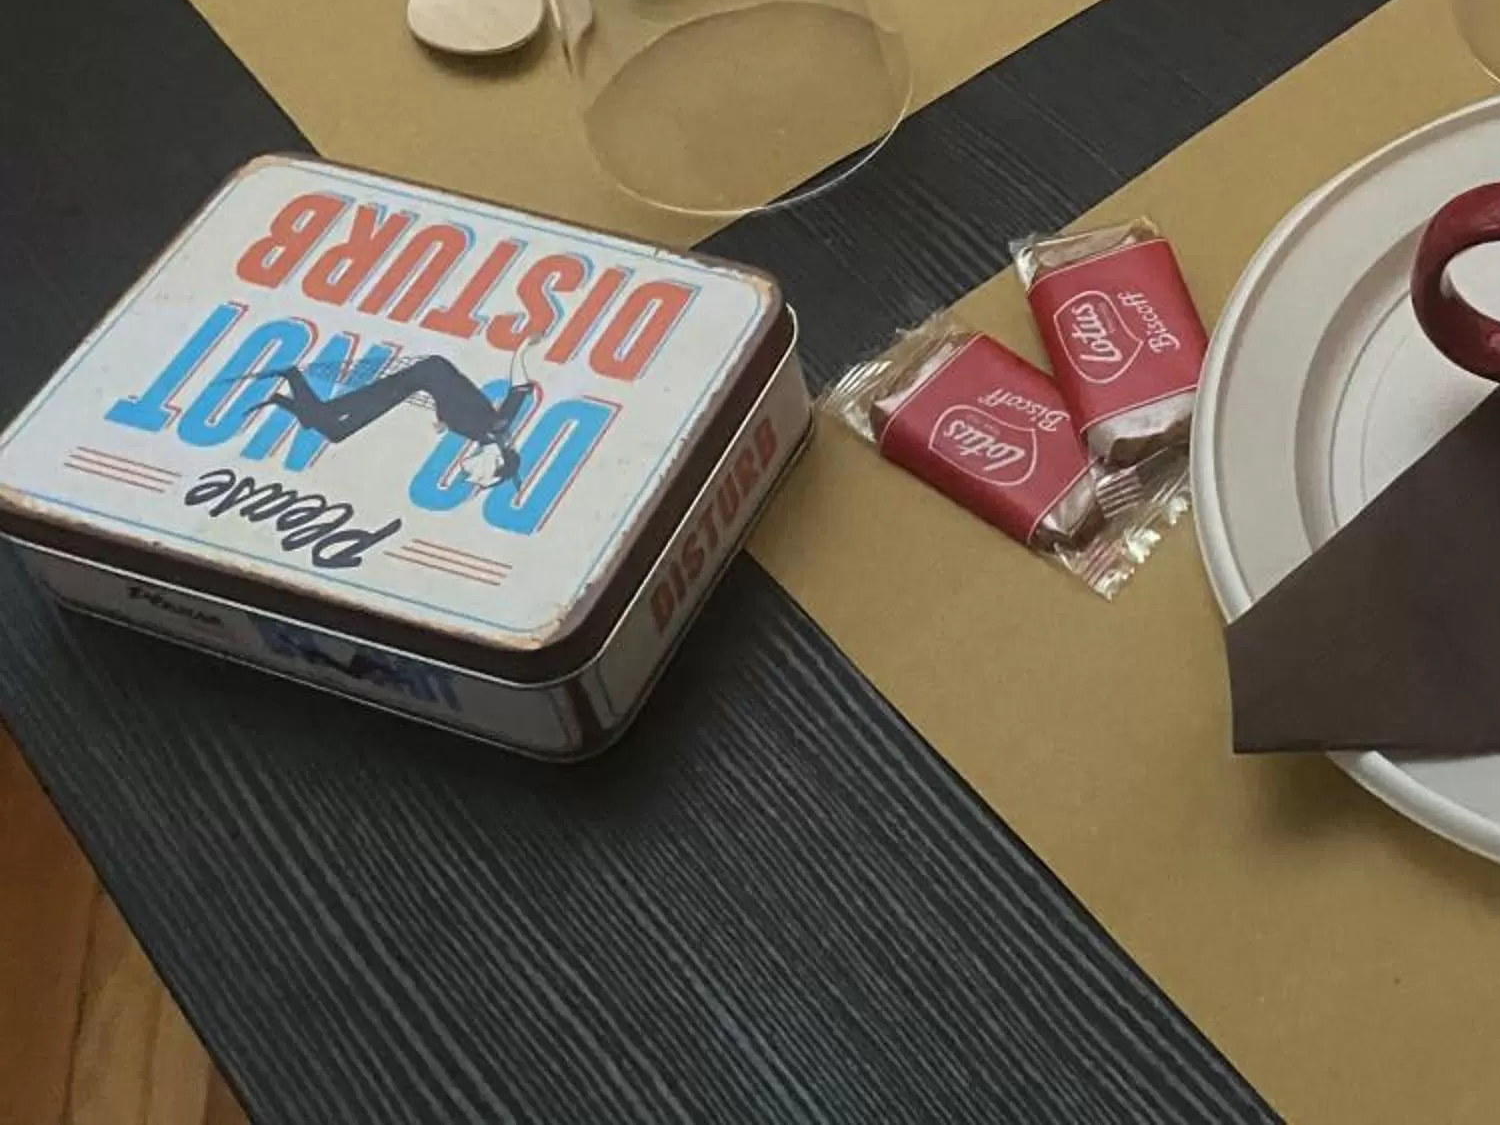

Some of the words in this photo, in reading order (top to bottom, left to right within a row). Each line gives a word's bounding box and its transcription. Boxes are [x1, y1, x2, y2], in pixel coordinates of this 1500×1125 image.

[236, 190, 701, 382] DISTURB
[1070, 302, 1123, 363] Lotus
[1116, 290, 1181, 354] Biscoff
[103, 299, 402, 473] NOT
[976, 387, 1072, 433] Biscoff
[408, 375, 622, 536] DO
[942, 417, 1026, 473] Lotus
[183, 467, 403, 570] Please
[648, 417, 779, 638] DISTURB
